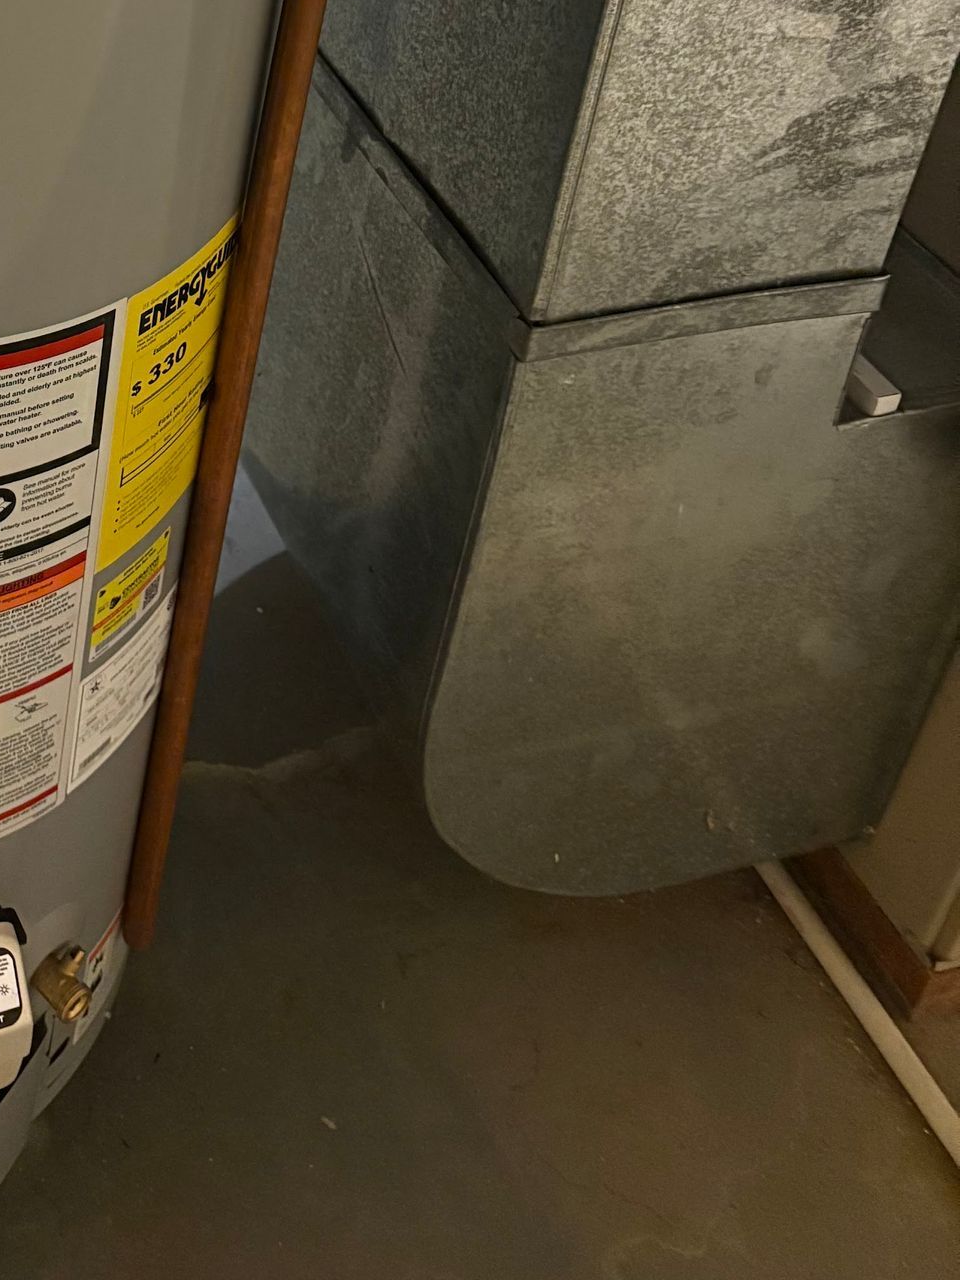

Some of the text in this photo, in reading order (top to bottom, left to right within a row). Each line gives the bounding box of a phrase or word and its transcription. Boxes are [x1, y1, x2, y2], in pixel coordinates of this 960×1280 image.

[15, 368, 32, 377] over
[54, 358, 66, 366] can
[68, 351, 87, 361] cause
[37, 369, 57, 379] death
[58, 363, 74, 373] from
[131, 342, 187, 397] $ 330
[27, 382, 51, 393] elderly
[53, 378, 63, 386] are
[73, 365, 97, 378] highest
[0, 408, 26, 419] manual
[27, 401, 50, 412] before
[51, 393, 75, 405] setting
[6, 425, 32, 436] bathing
[16, 435, 38, 445] valves
